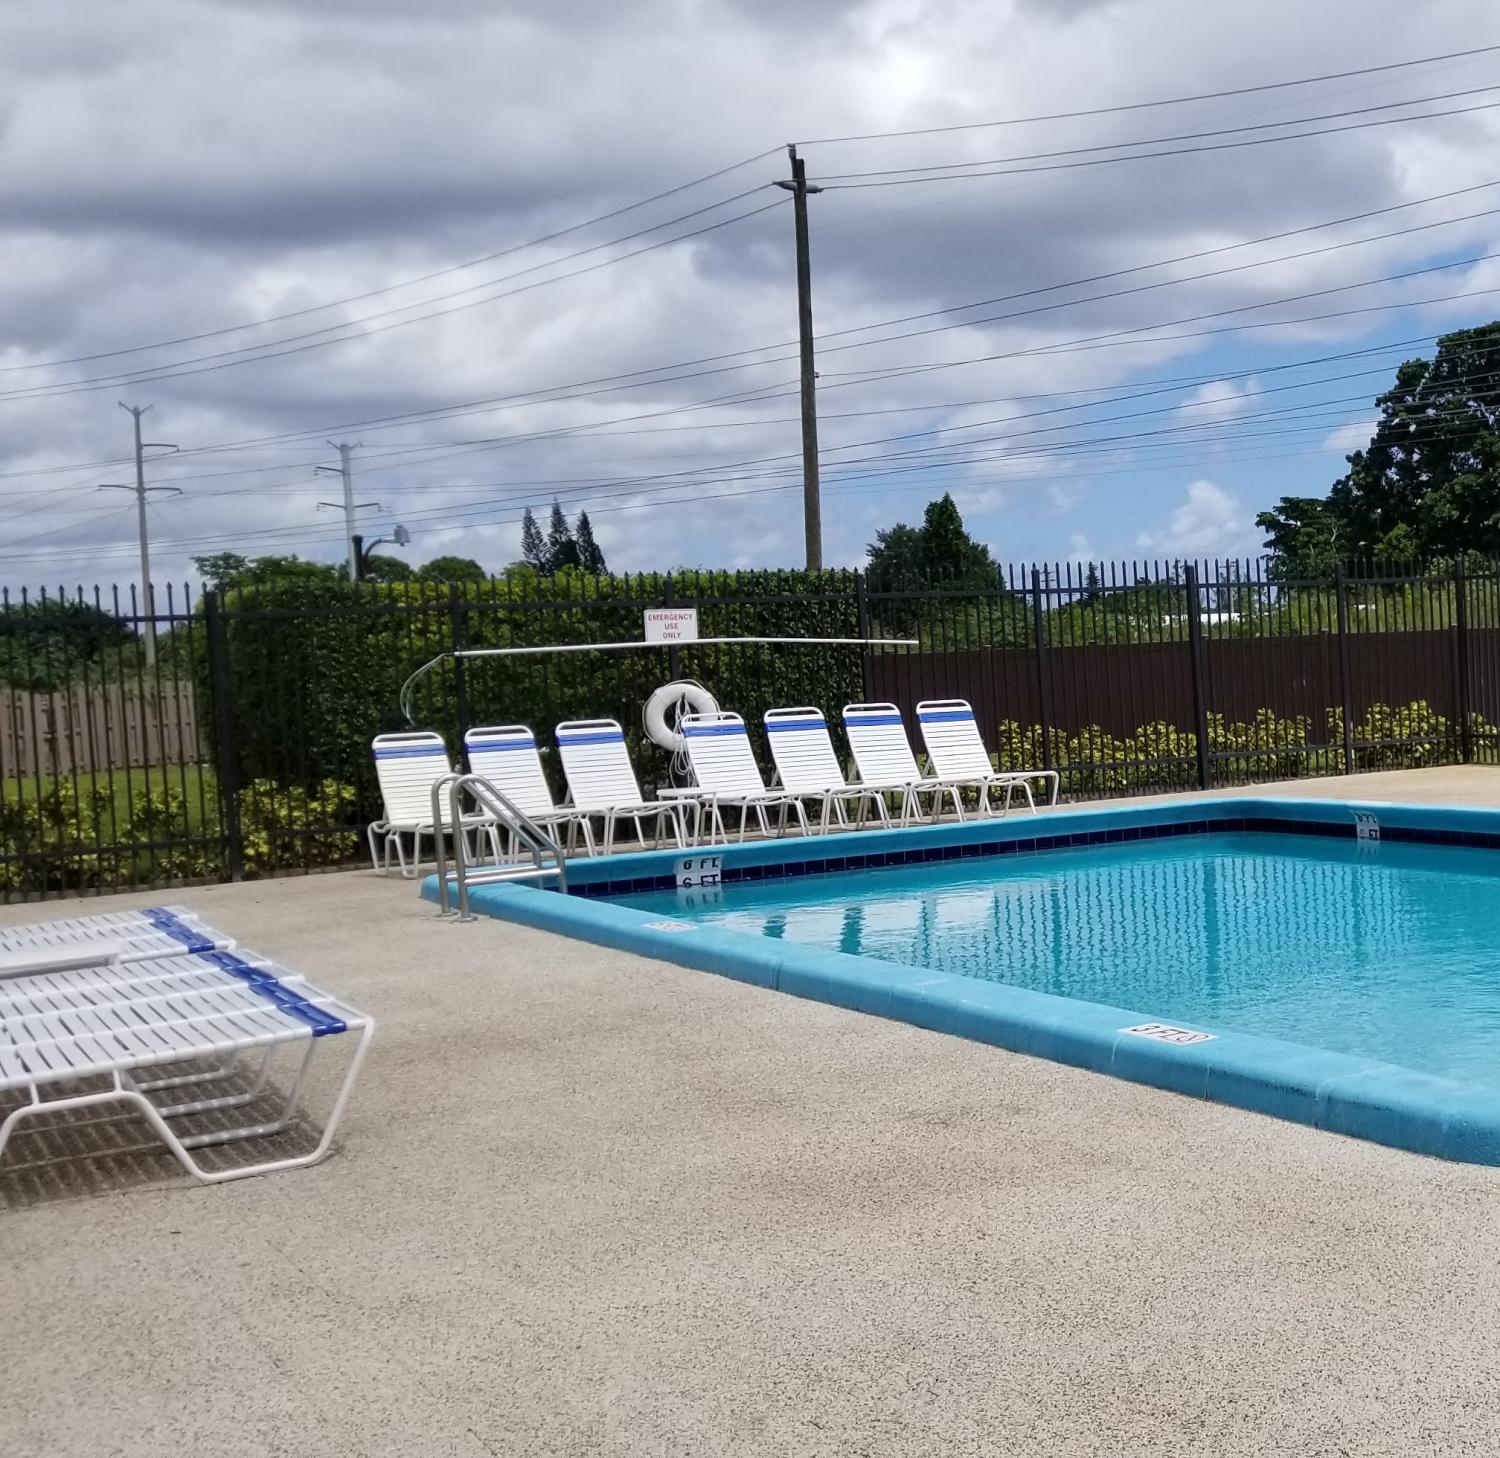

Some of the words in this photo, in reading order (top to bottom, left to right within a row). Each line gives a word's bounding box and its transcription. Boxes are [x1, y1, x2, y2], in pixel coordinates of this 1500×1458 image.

[648, 613, 693, 621] EMERGENCY
[664, 622, 679, 630] USE
[683, 859, 693, 870] 6
